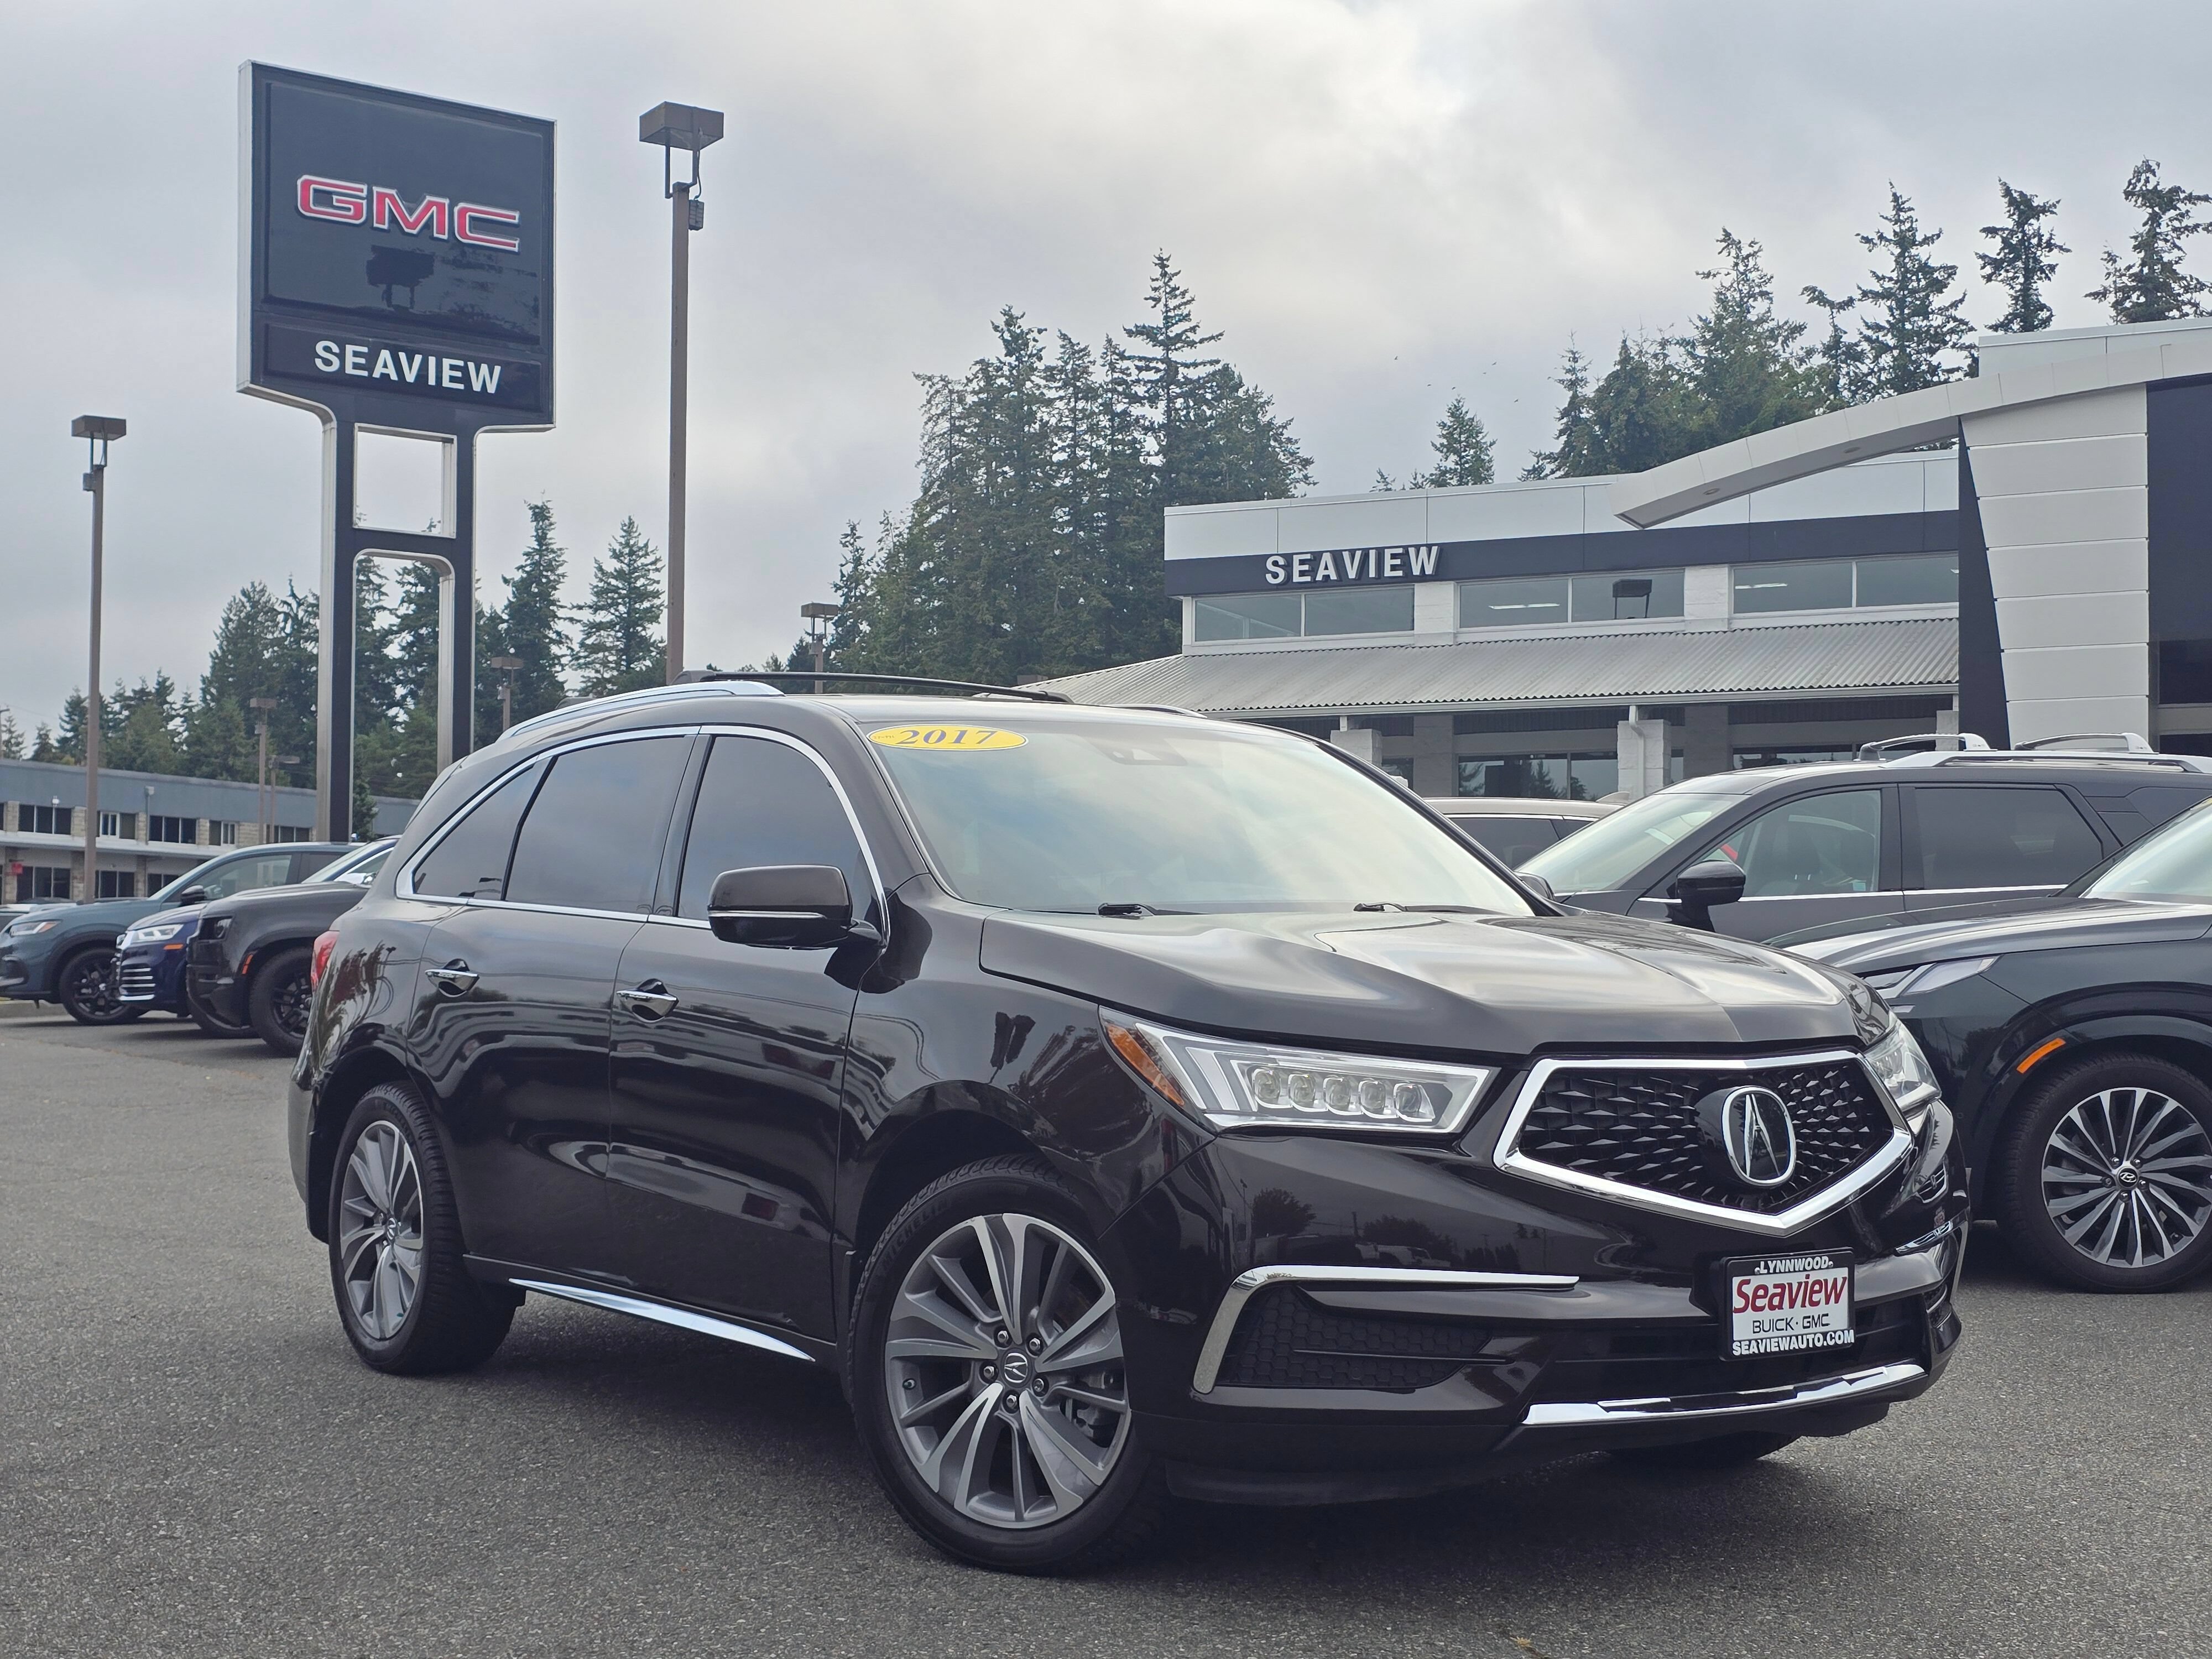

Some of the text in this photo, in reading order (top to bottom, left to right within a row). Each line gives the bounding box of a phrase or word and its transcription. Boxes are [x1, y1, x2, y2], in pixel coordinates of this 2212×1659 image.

[297, 174, 519, 252] GMC
[314, 340, 500, 394] SEAVIEW
[1265, 545, 1440, 585] SEAVIEW
[895, 729, 998, 745] 2017
[881, 1196, 952, 1271] MICHELIN
[1760, 1256, 1829, 1274] LYNNWOOD
[1733, 1274, 1847, 1313] Seaview
[1733, 1330, 1854, 1356] SEAVIEWAUTO.COM
[1752, 1313, 1830, 1334] BUICK GMC
